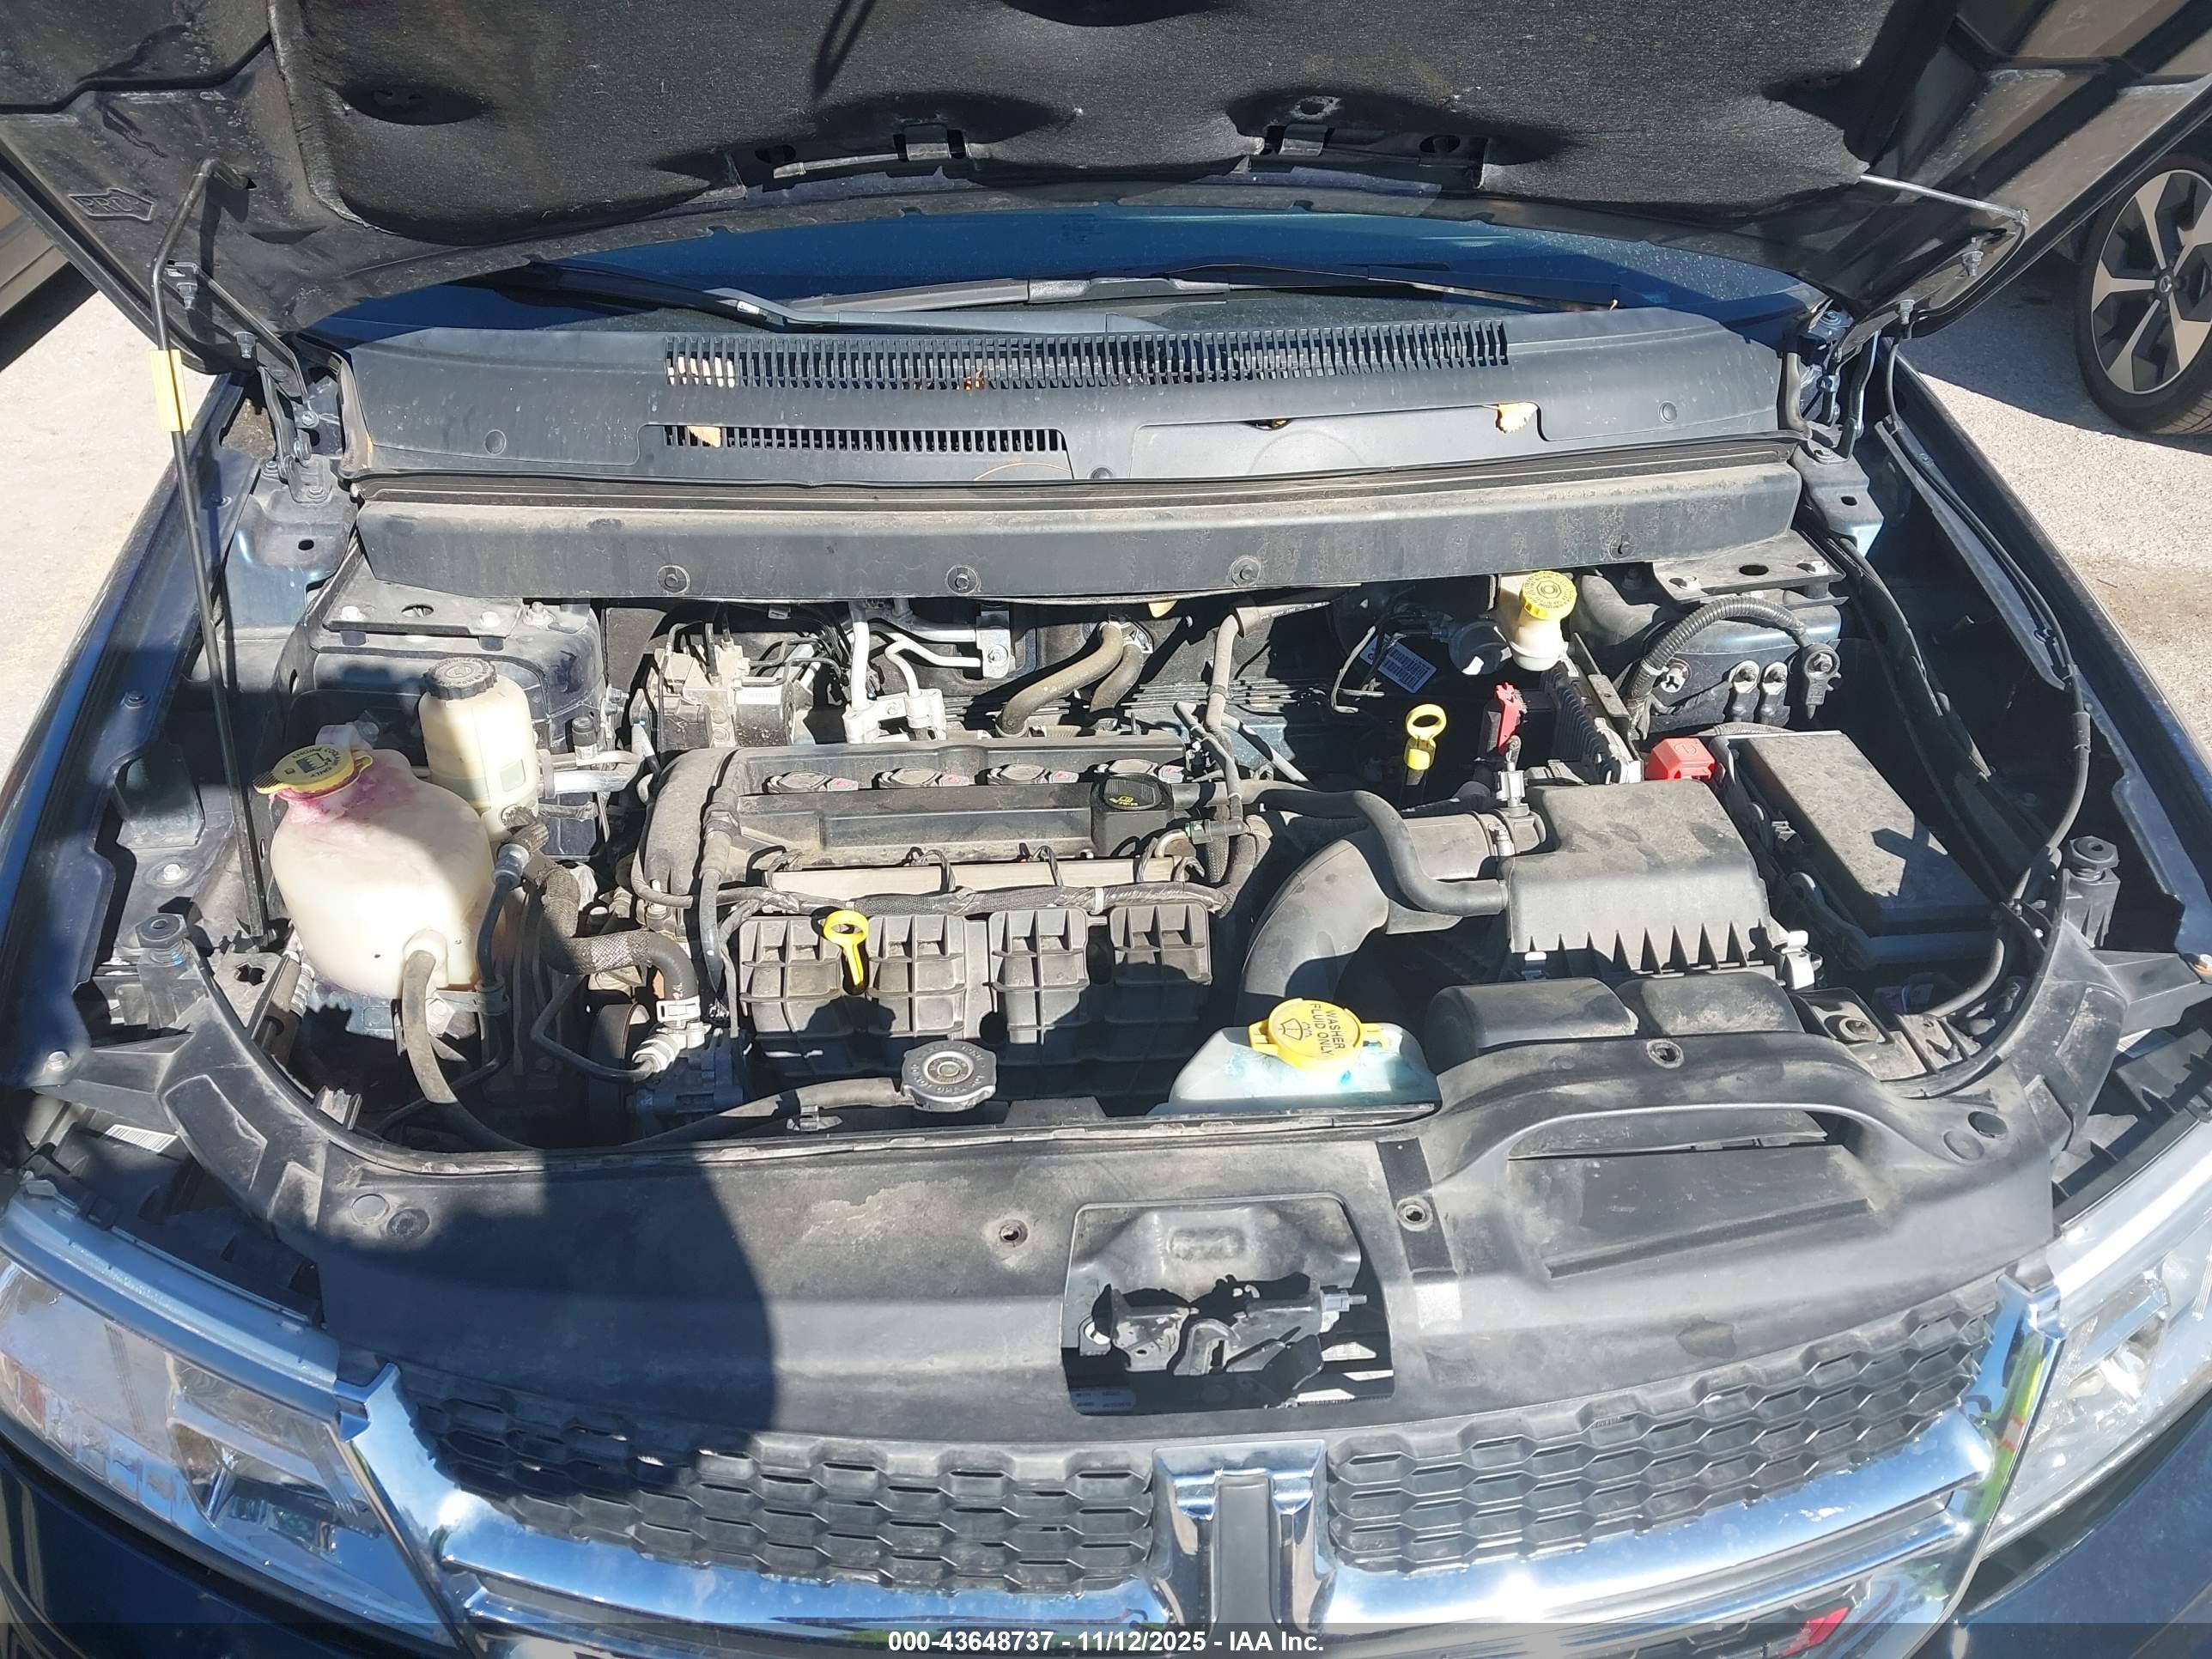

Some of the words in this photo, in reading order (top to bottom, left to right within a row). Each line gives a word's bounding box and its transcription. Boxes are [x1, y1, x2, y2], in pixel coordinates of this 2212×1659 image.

[76, 196, 139, 214] PROP
[1310, 1003, 1327, 1030] FLUID
[1325, 1009, 1346, 1049] WASHER
[1316, 1031, 1335, 1056] ONLY
